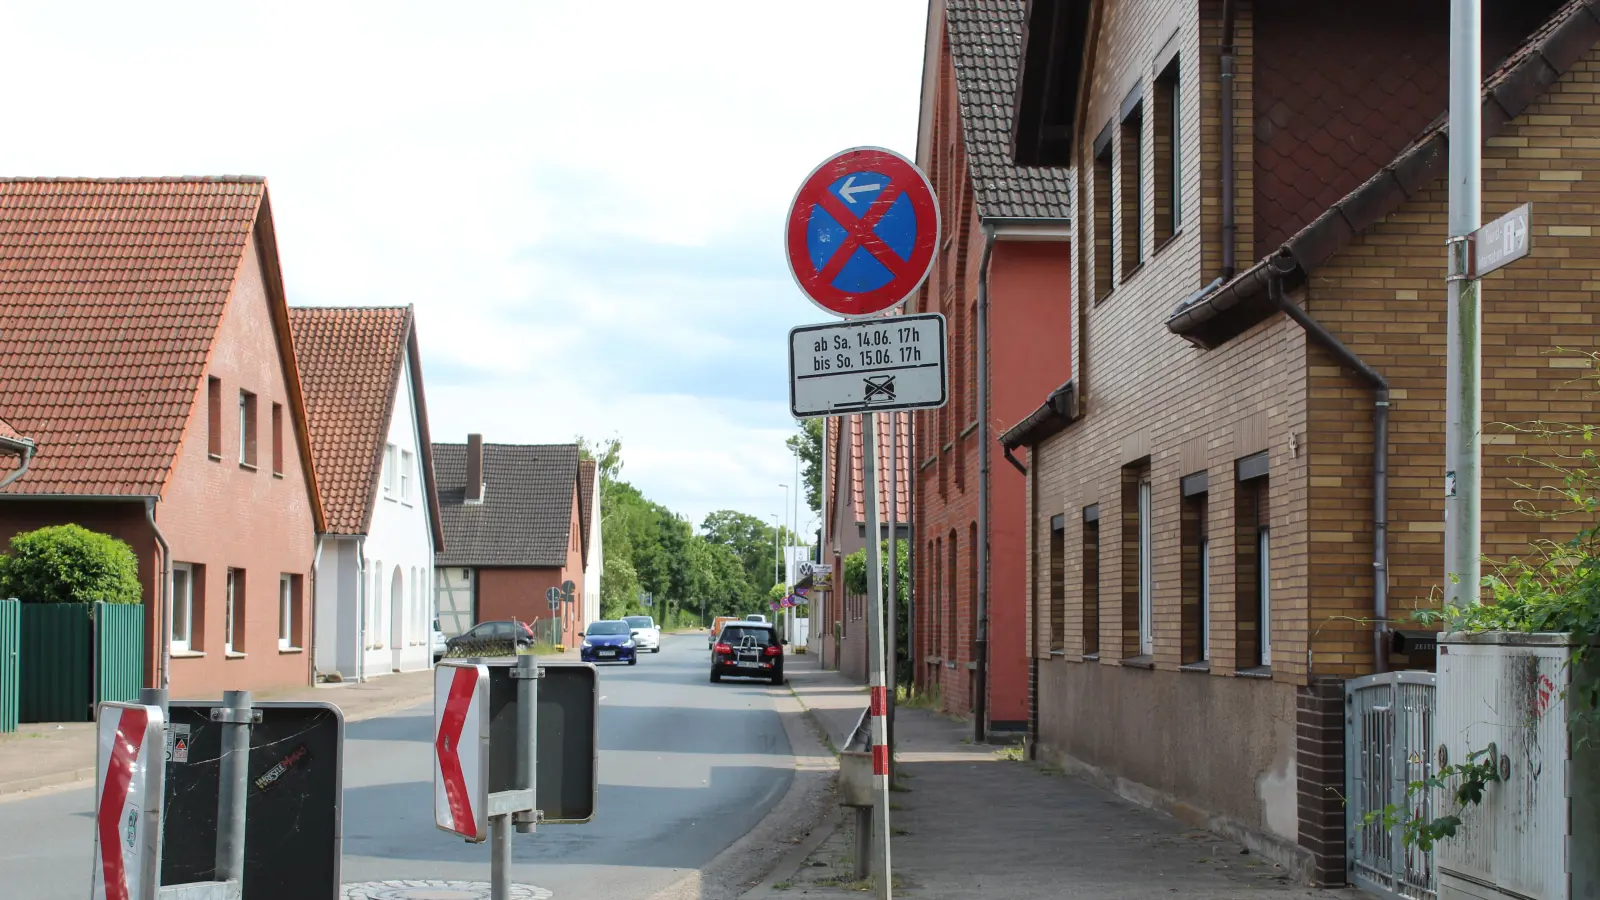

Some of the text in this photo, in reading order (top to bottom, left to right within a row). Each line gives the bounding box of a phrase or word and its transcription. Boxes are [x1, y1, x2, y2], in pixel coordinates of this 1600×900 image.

[814, 337, 828, 352] ab
[857, 330, 892, 347] 14.06.
[898, 327, 920, 343] 17h
[813, 356, 831, 371] bis
[860, 349, 893, 366] 15.06.
[900, 346, 921, 362] 17h
